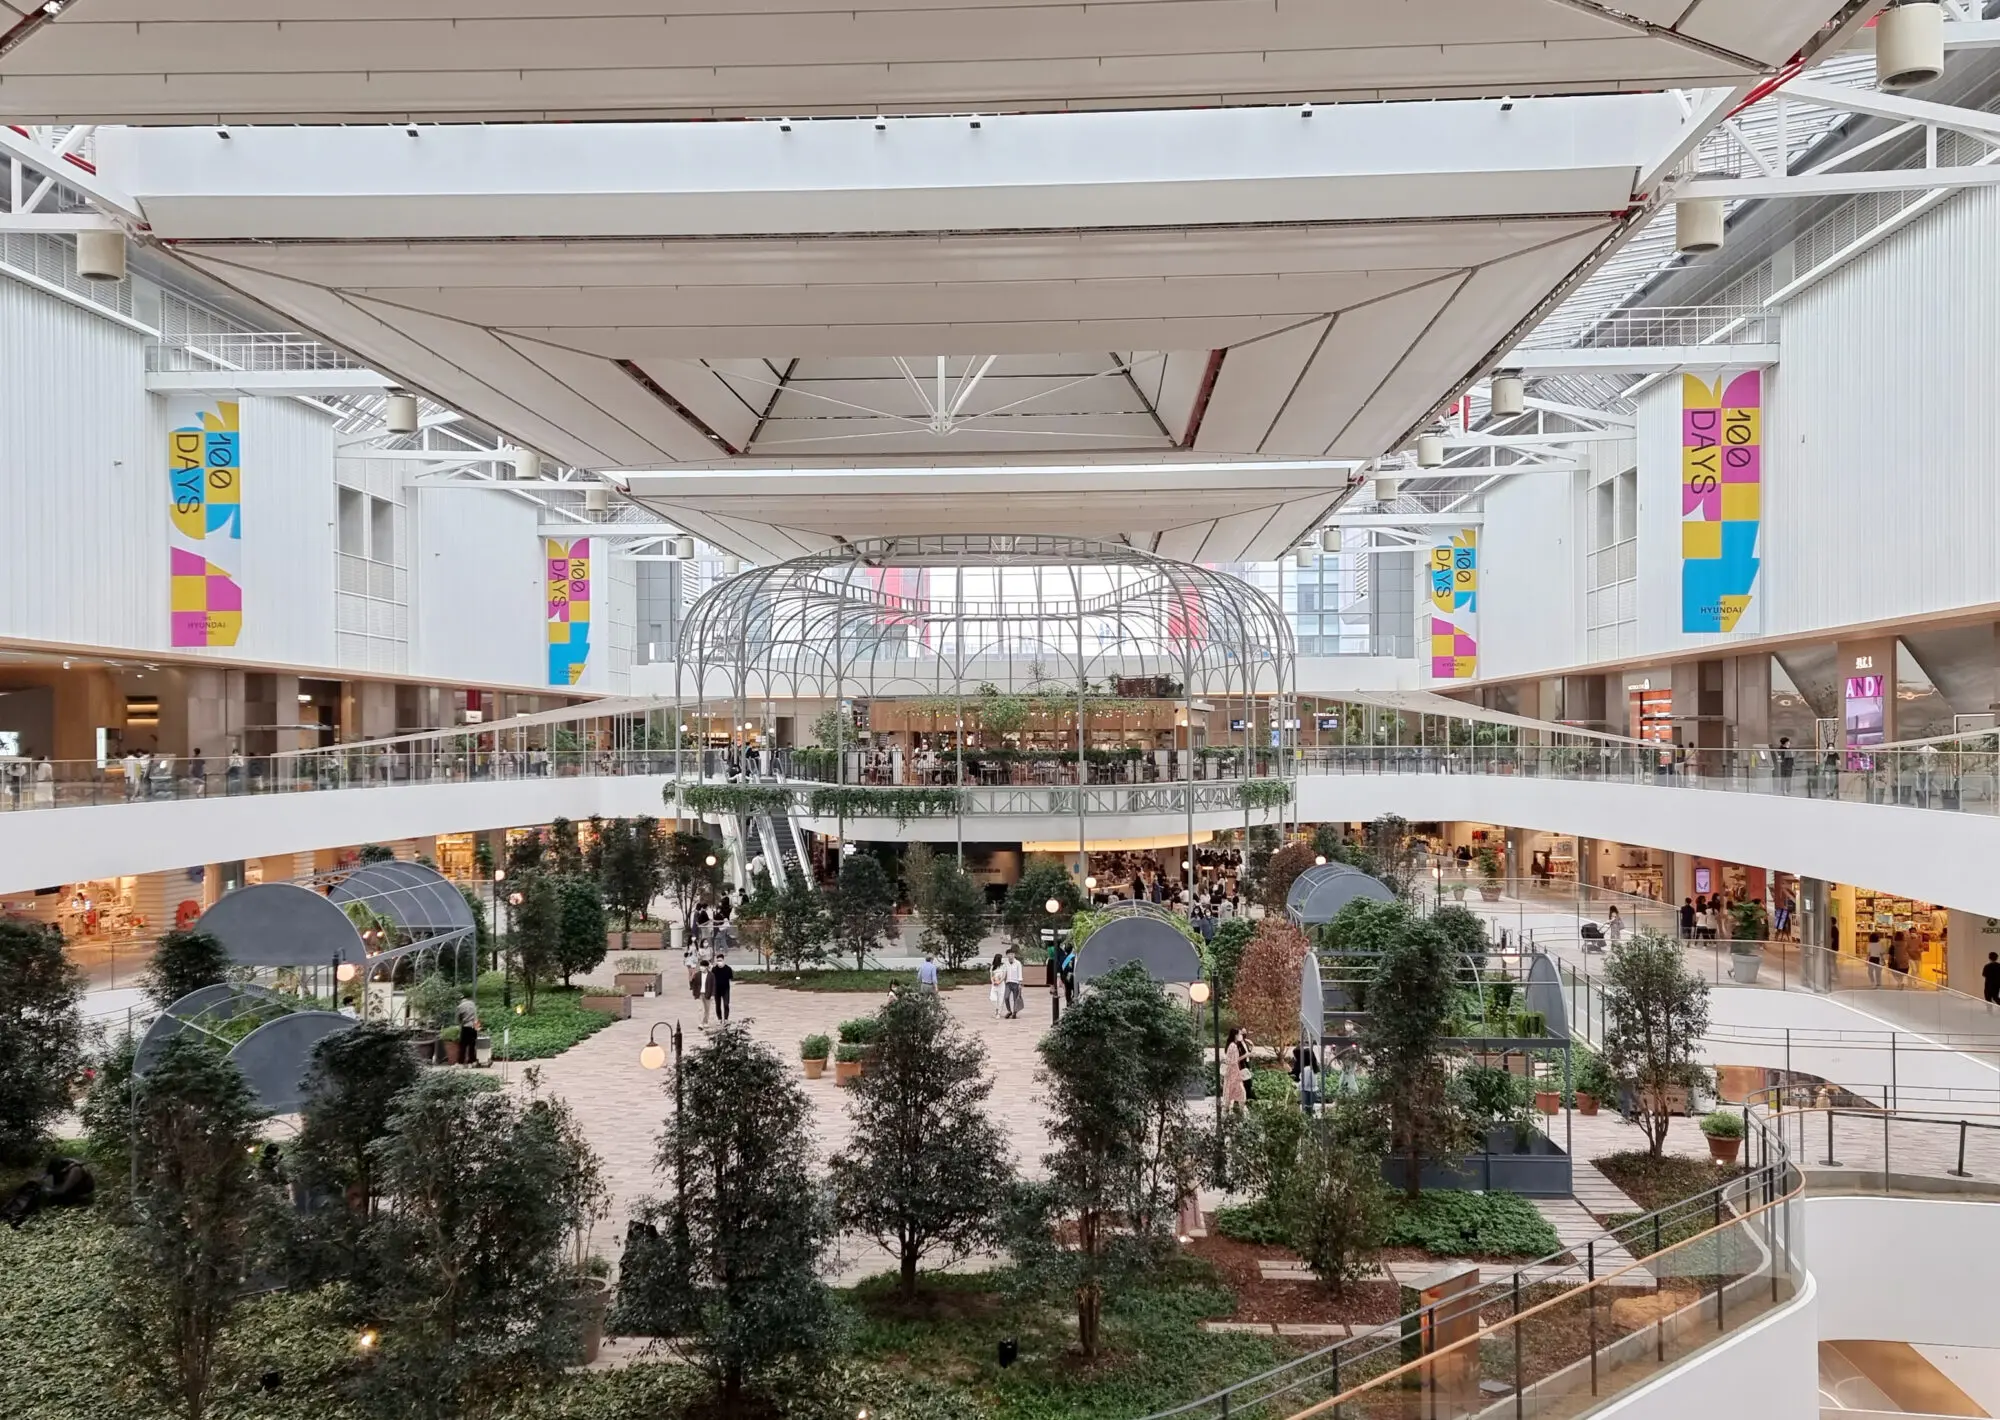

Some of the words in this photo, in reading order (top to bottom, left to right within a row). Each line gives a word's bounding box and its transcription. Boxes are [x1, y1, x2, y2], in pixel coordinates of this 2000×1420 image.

[208, 433, 232, 489] 100
[1691, 410, 1716, 494] DAYS
[1726, 409, 1751, 468] 100
[176, 434, 200, 515] DAYS
[552, 559, 567, 608] DAYS
[571, 559, 585, 593] 100
[1436, 549, 1451, 598] DAYS
[1456, 548, 1471, 583] 100
[187, 621, 226, 629] HYUNDAI
[1700, 606, 1742, 614] HYUNDAI
[1846, 675, 1883, 698] ANDY
